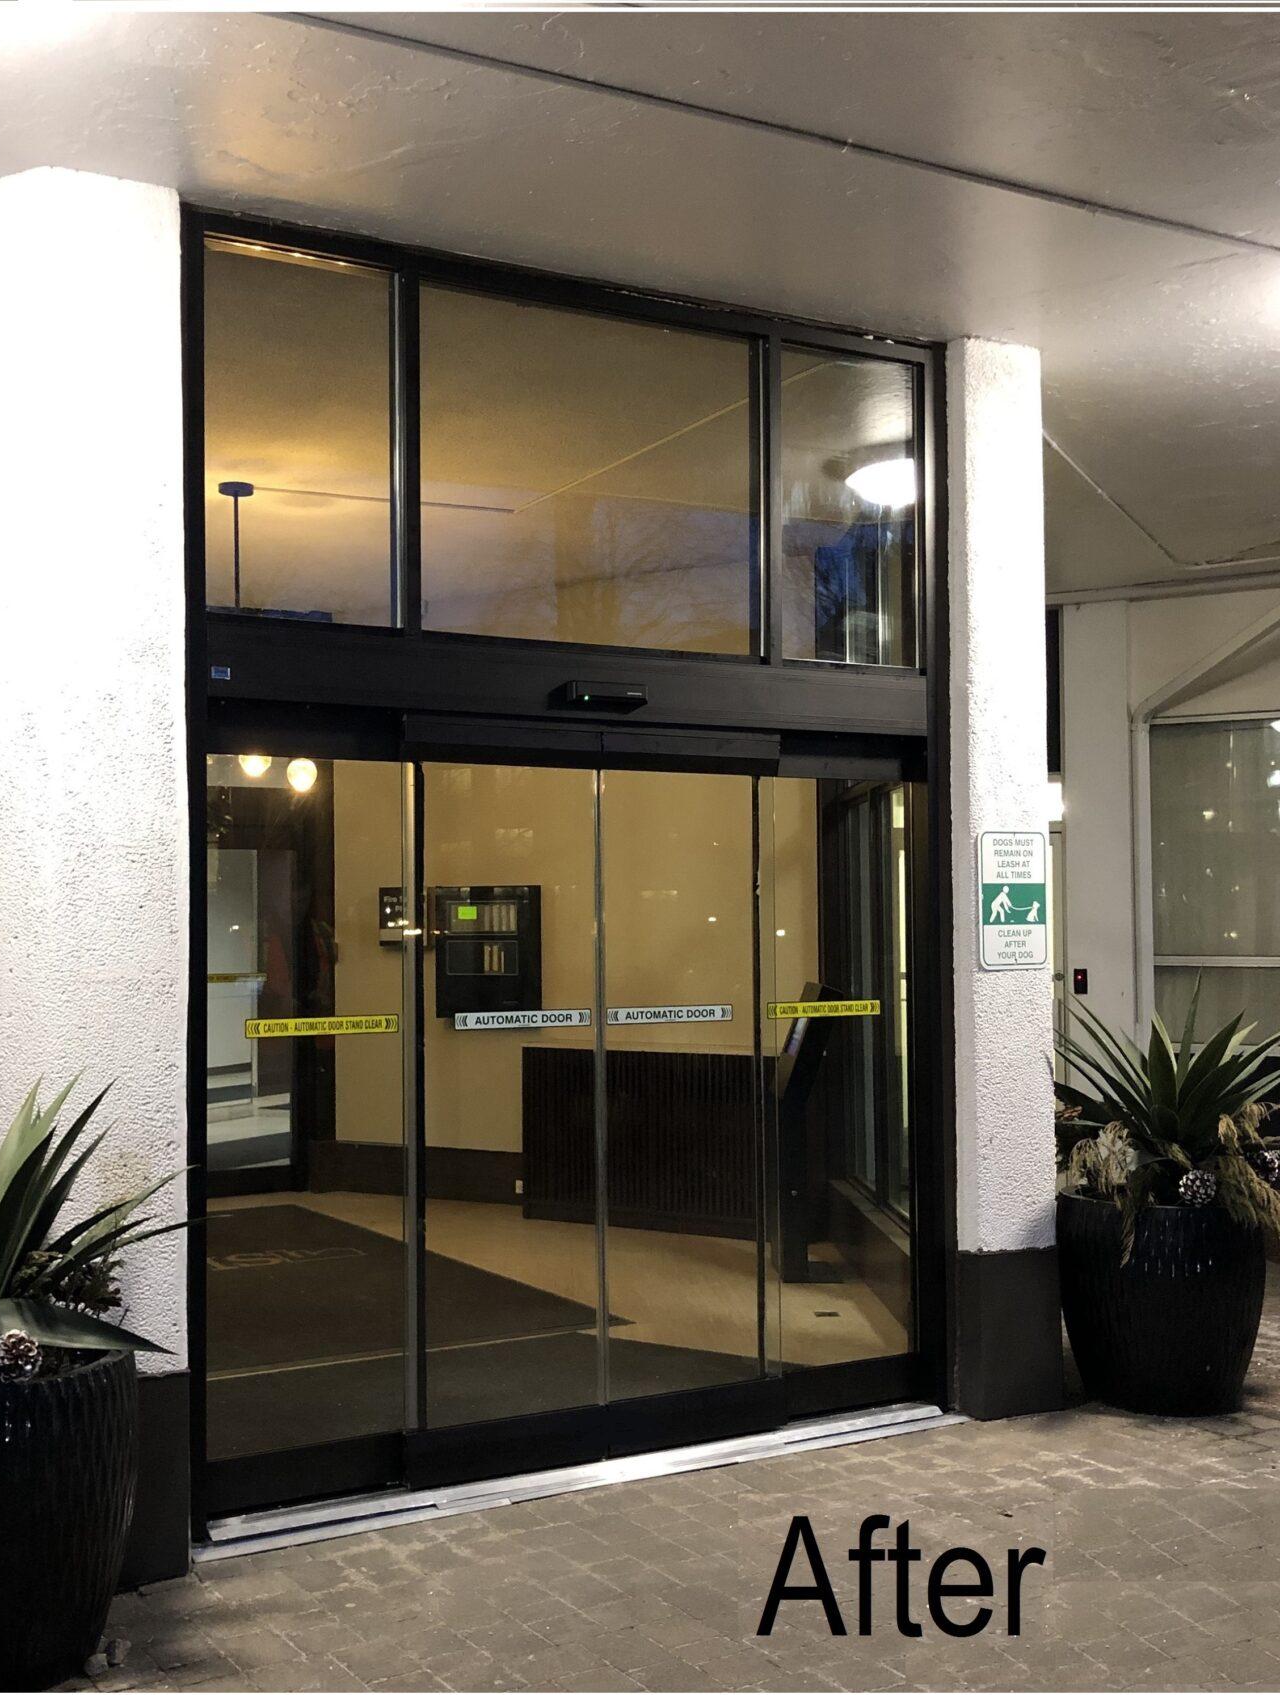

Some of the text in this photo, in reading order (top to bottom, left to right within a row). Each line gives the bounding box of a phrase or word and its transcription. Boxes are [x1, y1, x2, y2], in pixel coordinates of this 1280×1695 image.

[992, 838, 1034, 847] DOGS MUST
[993, 849, 1034, 857] REMAIN ON
[997, 860, 1031, 868] LEASH AT
[996, 870, 1032, 879] ALL TIMES
[997, 929, 1032, 938] CLEAN UP
[1004, 940, 1027, 948] AFTER
[997, 950, 1034, 959] YOUR DOG
[780, 1006, 799, 1014] CAUTION
[801, 1004, 827, 1014] AUTOMATIC
[827, 1005, 840, 1013] DOOR
[840, 1004, 855, 1013] STAND
[855, 1003, 869, 1012] CLEAR
[625, 1008, 716, 1021] AUTOMATIC DOOR
[474, 1013, 573, 1026] AUTOMATIC DOOR
[263, 1022, 289, 1034] CAUTION
[294, 1021, 328, 1032] AUTOMATIC
[328, 1021, 344, 1031] DOOR
[345, 1020, 363, 1030] STAND
[365, 1019, 383, 1029] CLEAR
